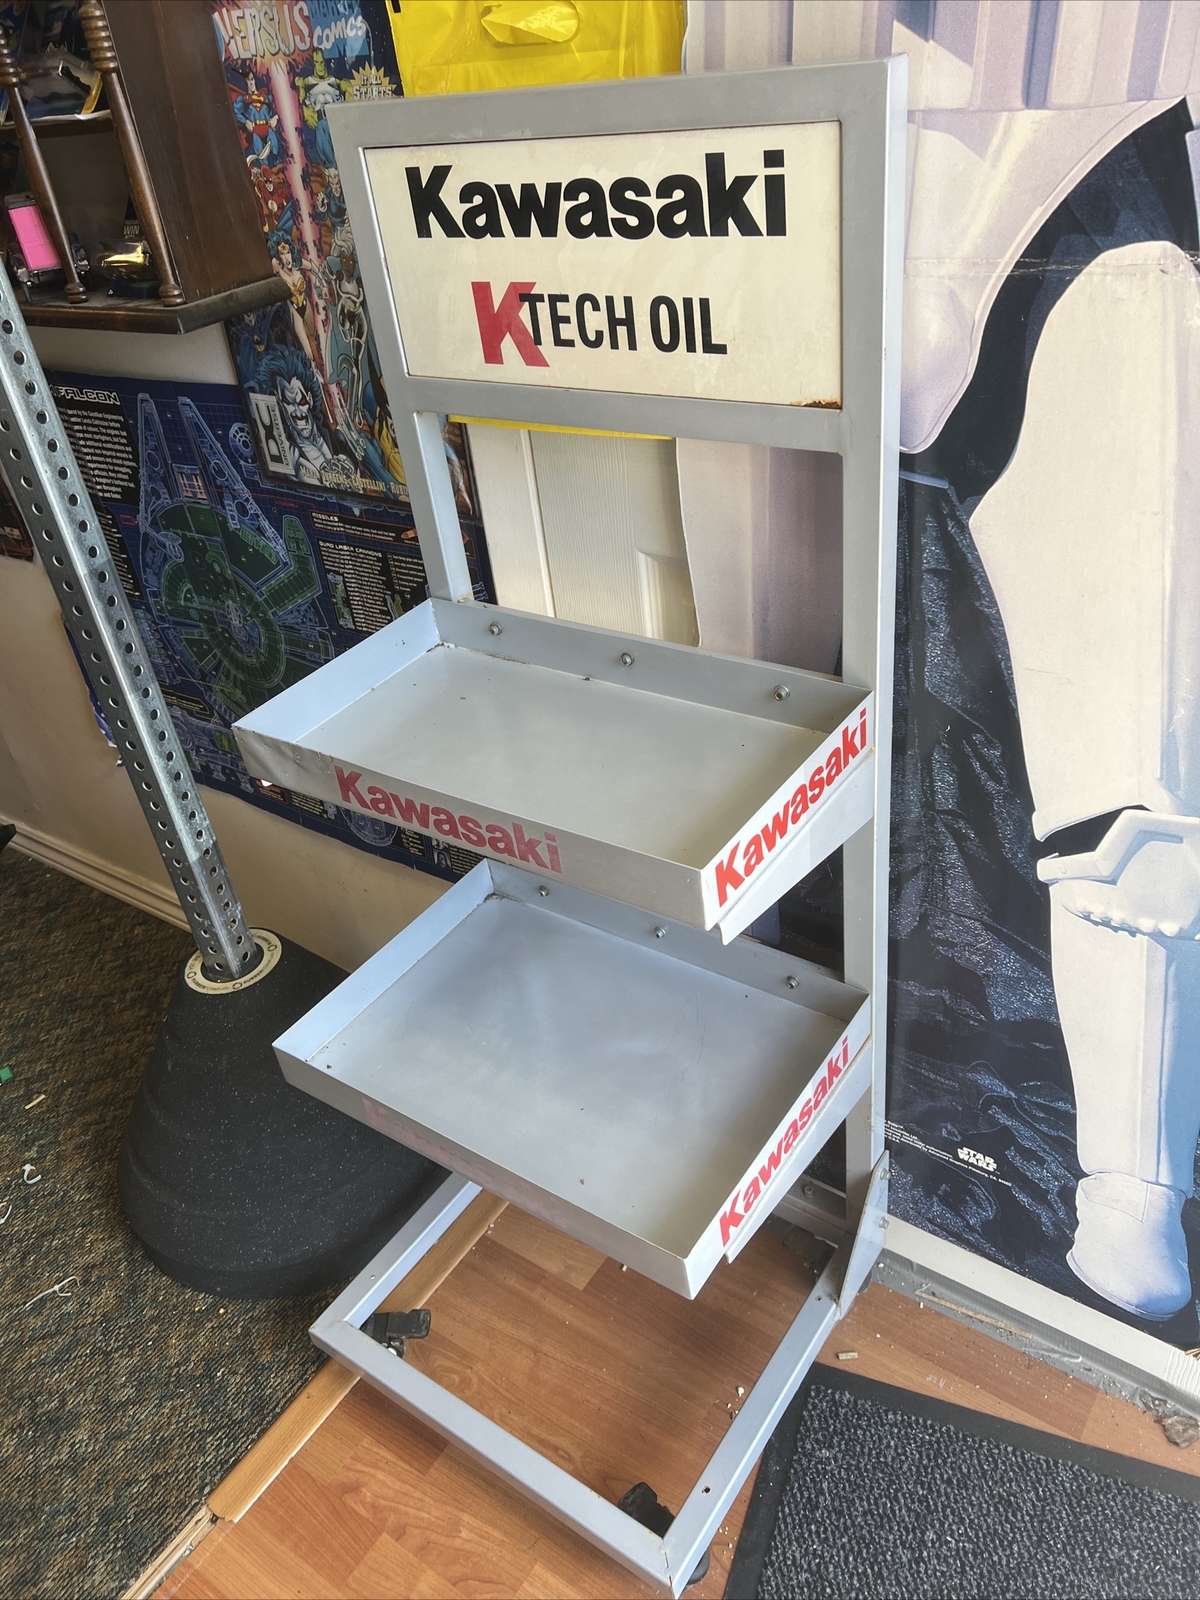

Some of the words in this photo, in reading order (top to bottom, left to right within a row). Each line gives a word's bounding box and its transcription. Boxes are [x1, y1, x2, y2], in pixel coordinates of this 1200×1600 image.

[213, 2, 311, 60] VERSUS
[313, 15, 366, 50] COMICS
[361, 75, 368, 86] IT
[370, 74, 382, 86] ALL
[405, 149, 787, 239] Kawasaki
[649, 295, 728, 355] OIL
[56, 386, 120, 405] FALCON
[334, 764, 563, 874] Kawasaki
[714, 706, 868, 909] Kawasaki
[718, 1035, 849, 1248] Kawasaki
[958, 1147, 995, 1163] STAR
[958, 1150, 997, 1172] WARS
